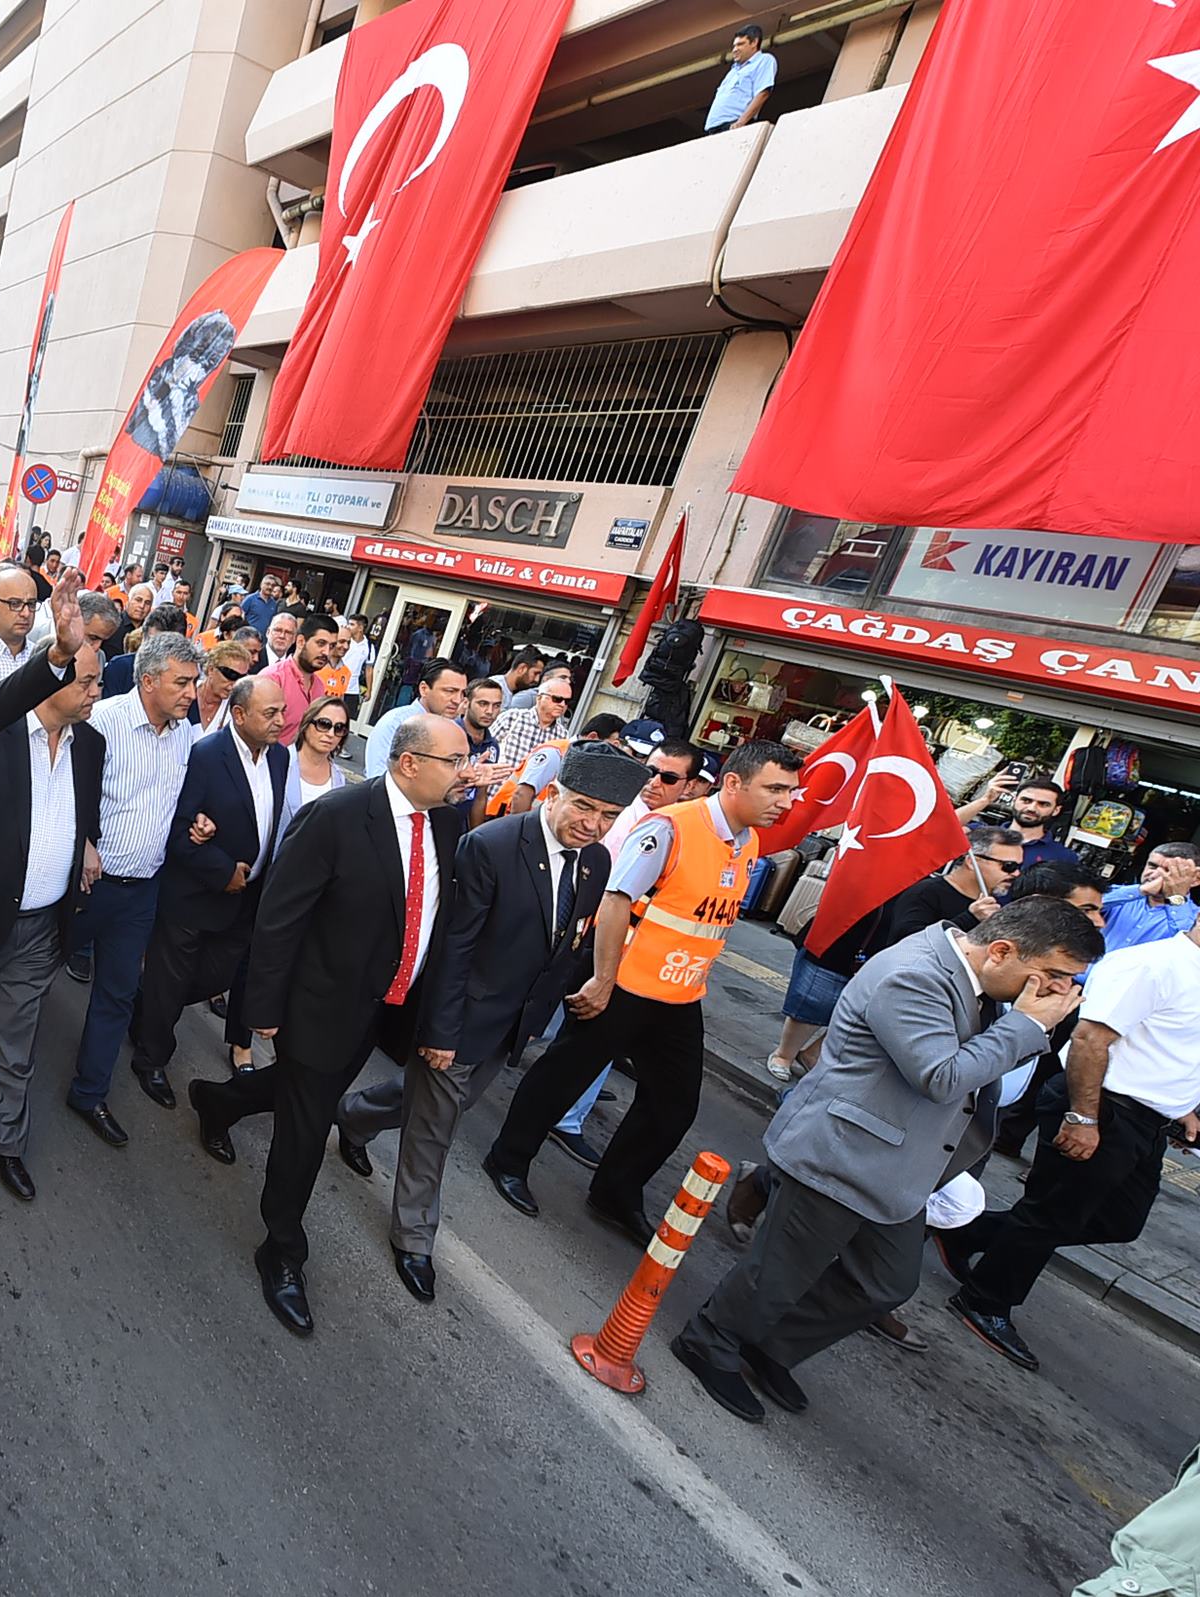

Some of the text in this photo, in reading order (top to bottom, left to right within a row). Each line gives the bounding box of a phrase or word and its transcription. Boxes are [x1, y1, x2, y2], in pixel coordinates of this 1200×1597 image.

[57, 477, 72, 490] WC
[325, 493, 370, 507] OTOPARK
[371, 500, 382, 508] ve
[257, 525, 283, 540] OTOPARK
[288, 530, 321, 548] ALIŞVERİŞ
[321, 535, 352, 551] MERKEZİ
[436, 492, 568, 538] DASCH
[364, 541, 598, 592] dasch Valiz & Çanta
[972, 543, 1131, 591] KAYIRAN
[781, 607, 1017, 663] ÇAĞDAŞ
